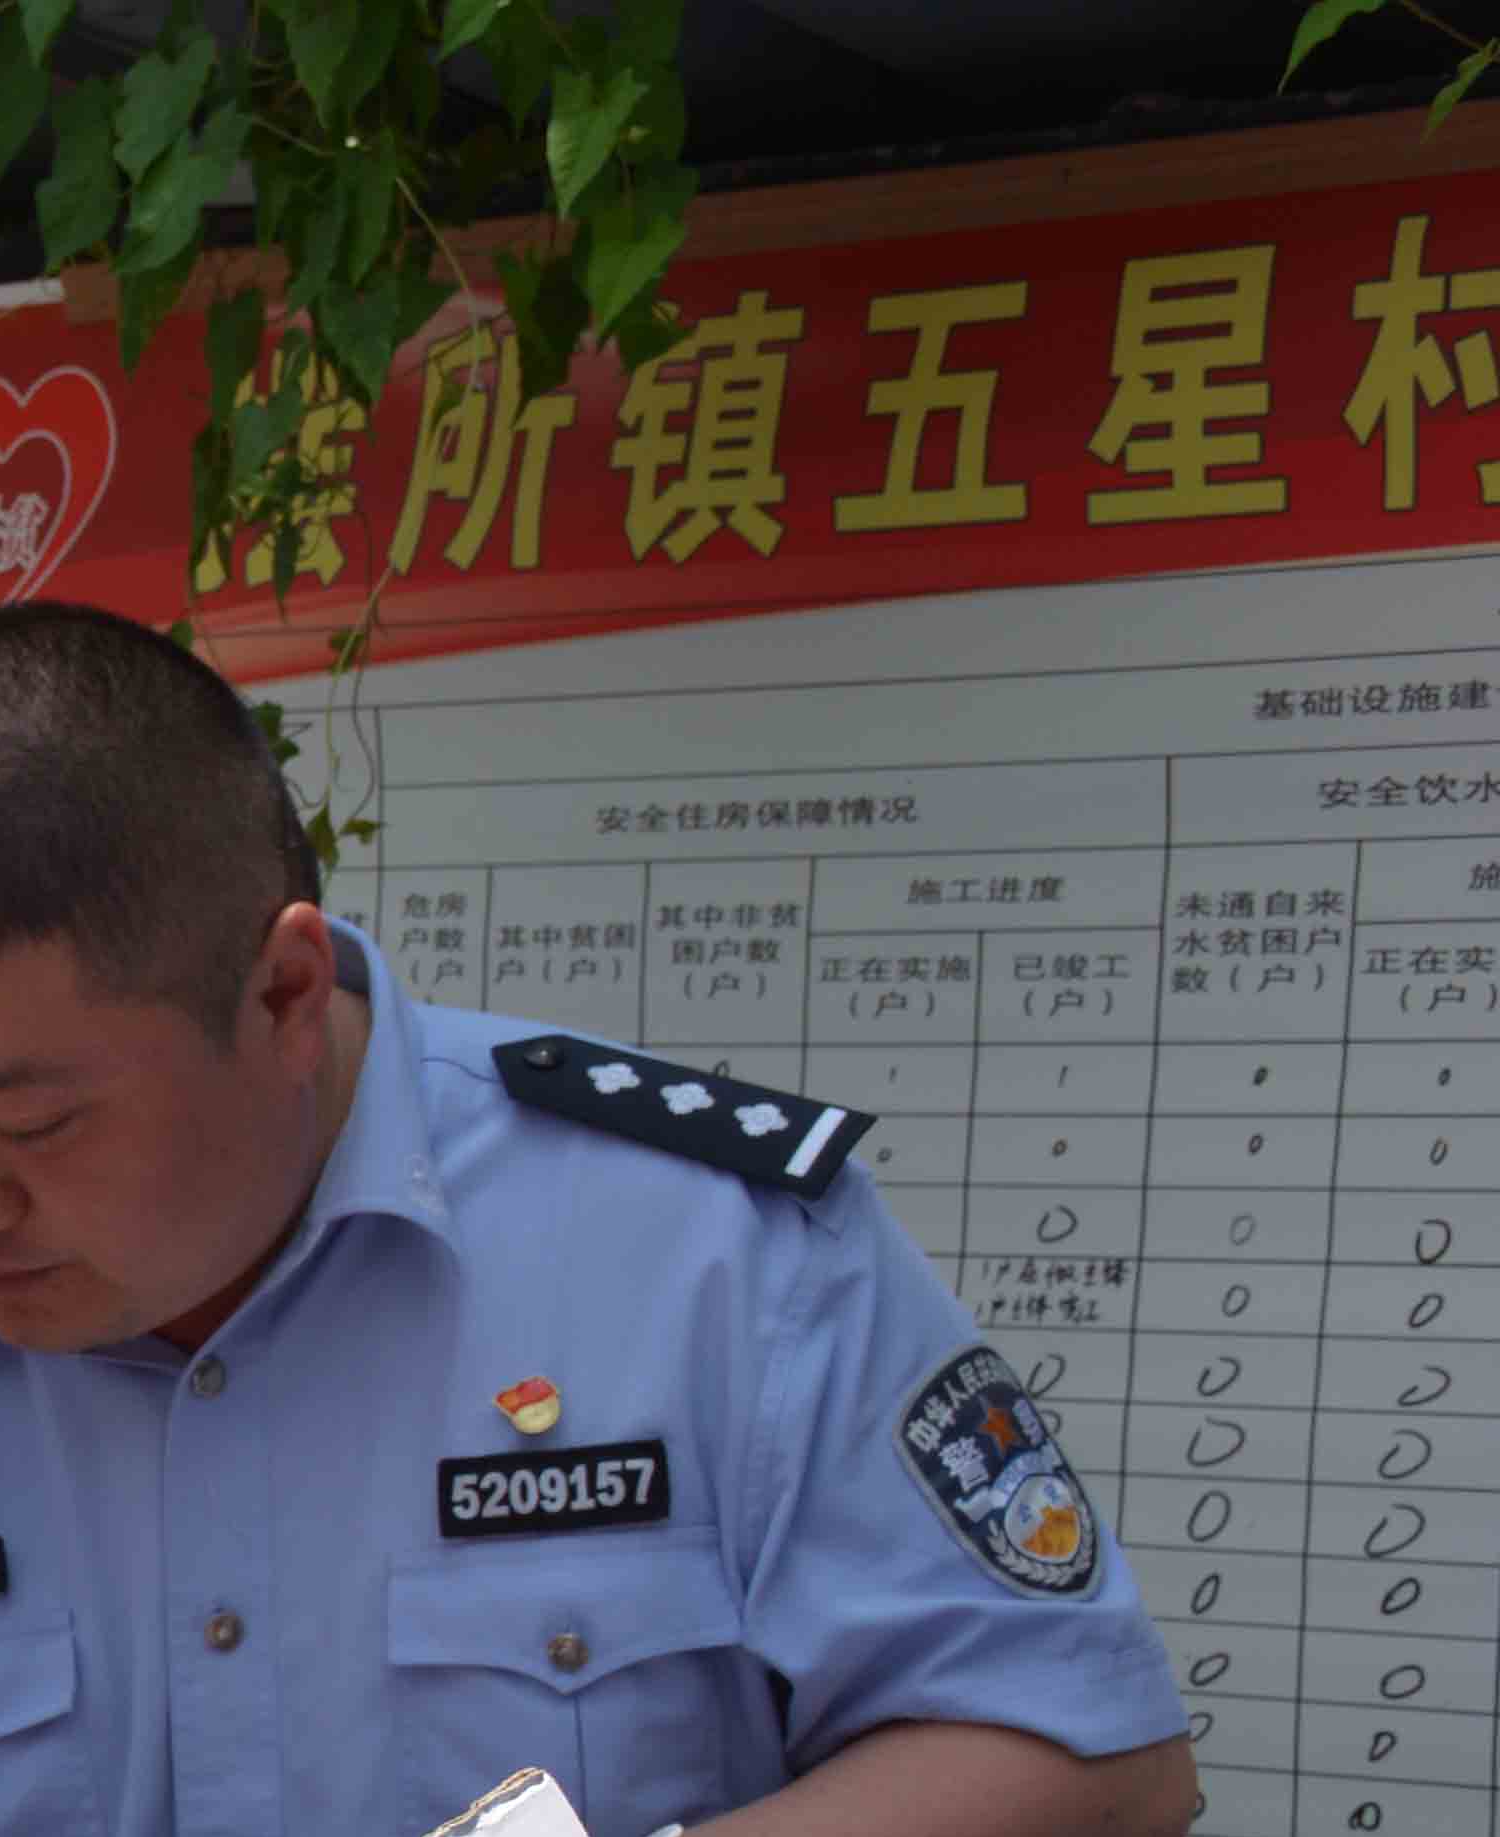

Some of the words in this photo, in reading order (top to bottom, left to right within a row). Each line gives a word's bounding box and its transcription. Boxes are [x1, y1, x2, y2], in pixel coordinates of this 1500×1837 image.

[1254, 678, 1490, 720] 基础设施建
[1318, 771, 1500, 809] 安全饮水
[596, 793, 917, 835] 安全住房保障情况
[905, 876, 1065, 904] 施工进度
[655, 903, 800, 931] 其中非贫
[1176, 889, 1346, 920] 未通自来
[399, 928, 465, 953] 户数
[497, 923, 636, 951] 其中贫困
[1176, 927, 1342, 956] 水贫困户
[672, 938, 780, 965] 困户数
[1361, 945, 1494, 975] 正在实
[819, 956, 971, 983] 正在实施
[1013, 953, 1129, 981] 已竣工
[450, 1457, 656, 1521] 5209157
